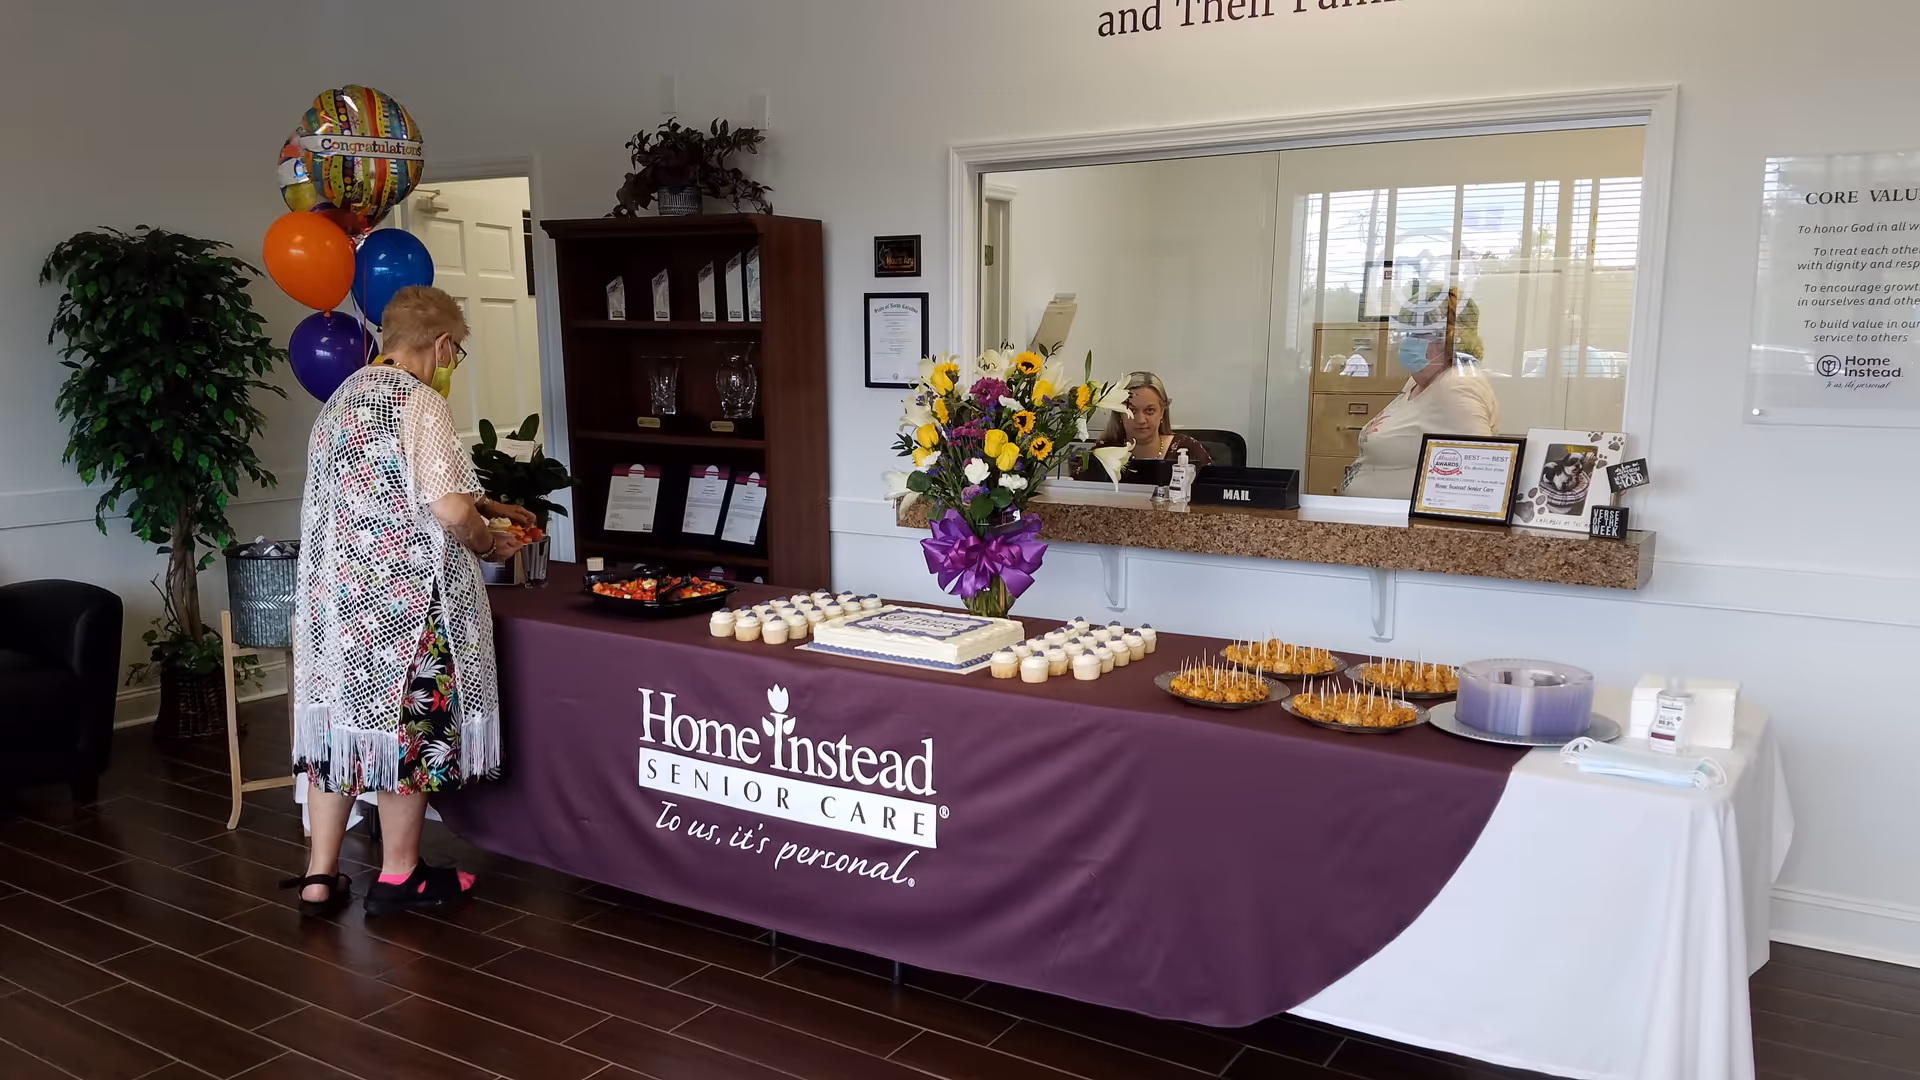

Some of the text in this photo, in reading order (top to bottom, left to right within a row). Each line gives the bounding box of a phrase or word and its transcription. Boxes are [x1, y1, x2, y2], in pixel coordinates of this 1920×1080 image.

[1098, 0, 1161, 37] and
[321, 138, 421, 156] Congratulations
[1805, 188, 1920, 205] CORE VALU
[1798, 225, 1811, 234] To
[1814, 224, 1848, 234] honor
[1851, 223, 1875, 233] God
[1877, 222, 1888, 232] in
[1891, 221, 1907, 231] all
[1813, 244, 1920, 256] To treat each othe
[1797, 259, 1920, 273] with dignity and resp
[1804, 283, 1920, 294] To encourage growt
[1797, 296, 1920, 306] in ourselves and othe
[1804, 320, 1817, 329] To
[1819, 320, 1849, 329] build
[1851, 319, 1883, 329] value
[1886, 319, 1898, 329] in
[1813, 333, 1908, 342] service to others
[1845, 356, 1891, 366] Home
[1223, 488, 1251, 501] MAIL
[1593, 509, 1620, 521] VERSE
[1592, 517, 1619, 528] OF THE
[1592, 525, 1618, 537] WEEK
[638, 688, 937, 796] Home Instead
[646, 758, 925, 836] SENIOR CARE
[656, 801, 681, 831] To
[688, 822, 721, 845] us,
[729, 823, 770, 853] it's
